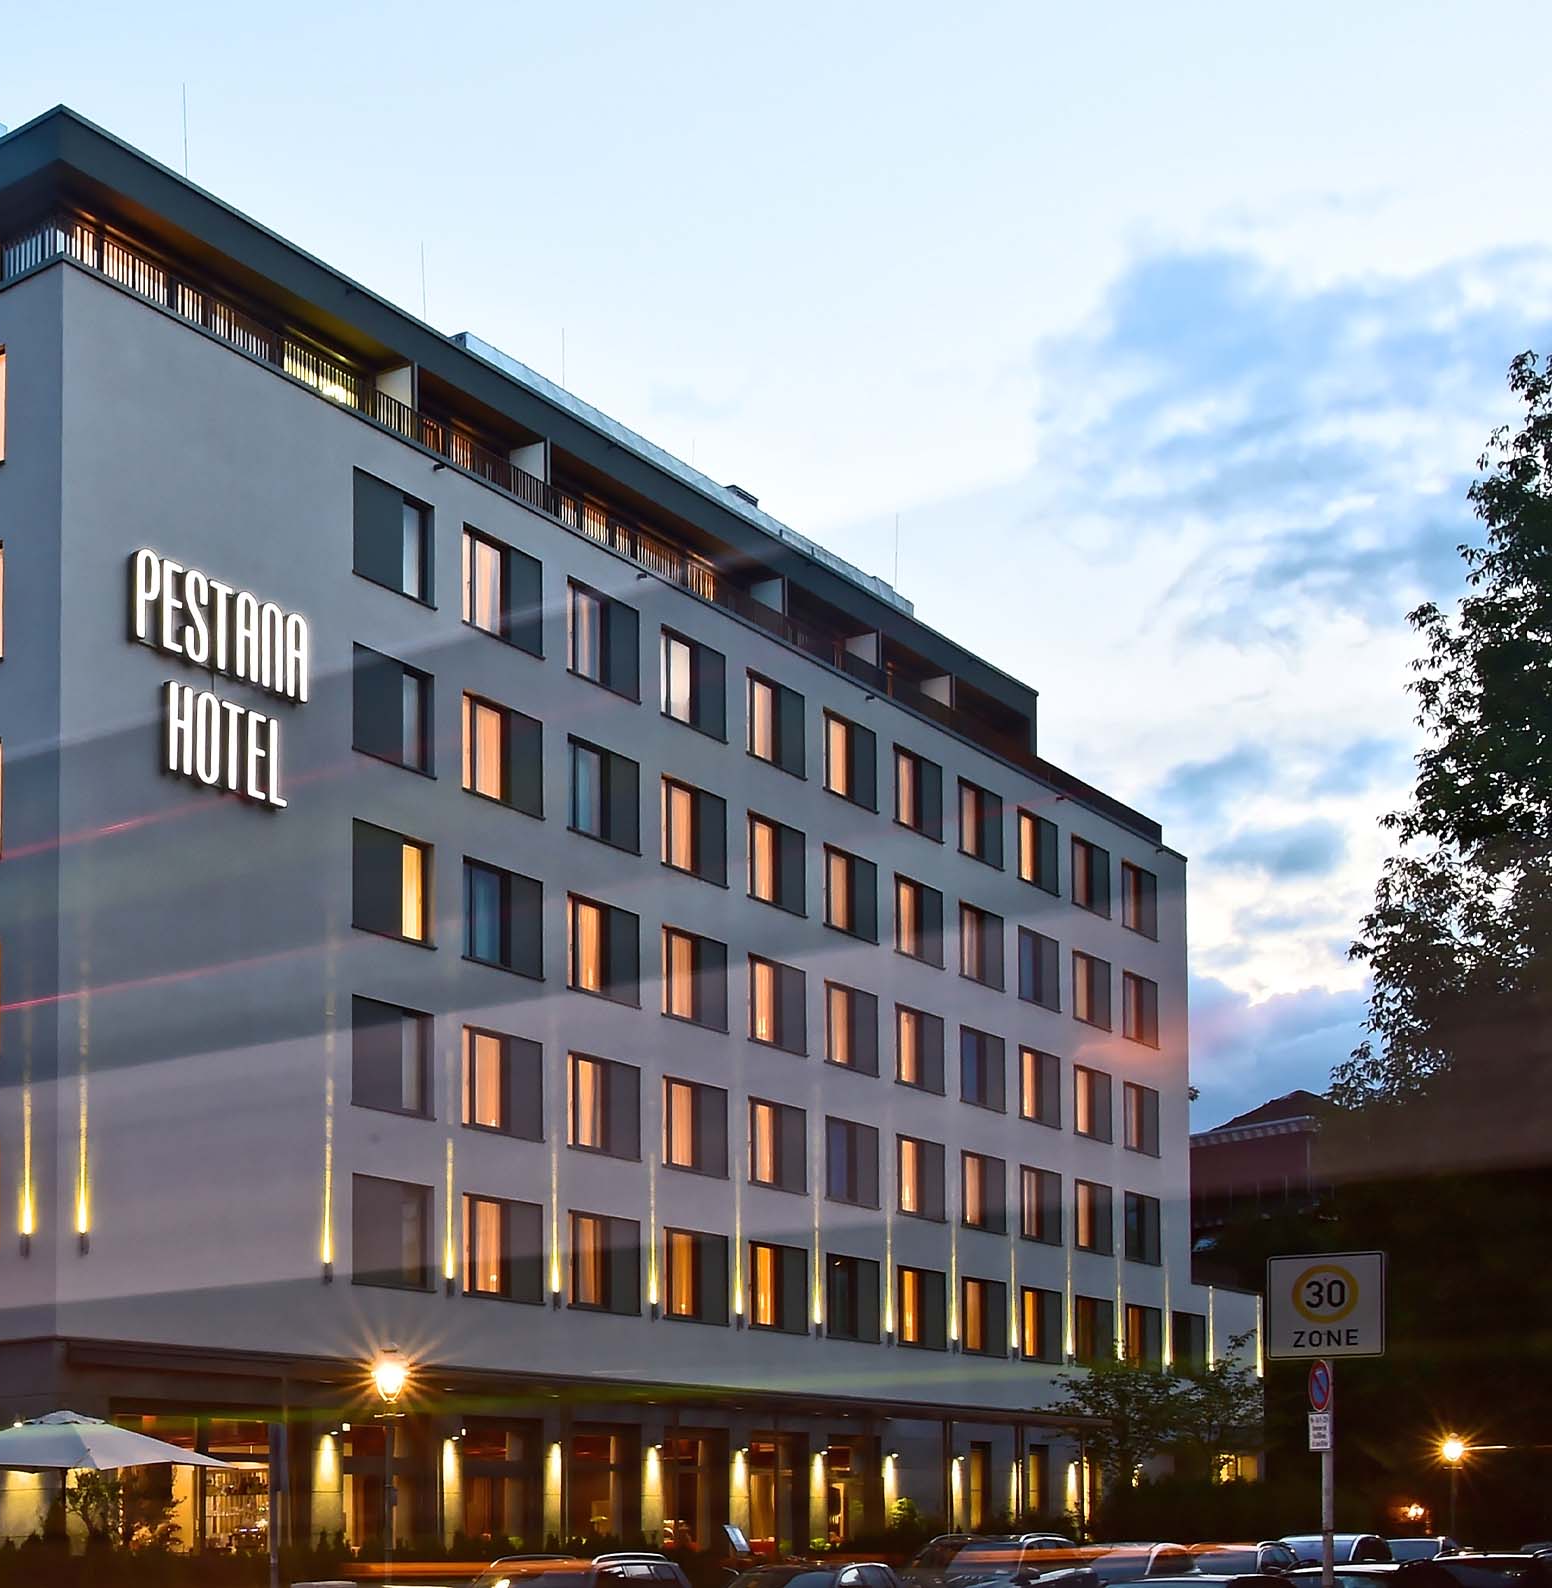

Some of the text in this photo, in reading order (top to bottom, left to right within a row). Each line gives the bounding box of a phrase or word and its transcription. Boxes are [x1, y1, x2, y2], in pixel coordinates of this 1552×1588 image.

[133, 547, 309, 704] PESTANA
[167, 680, 288, 809] HOTEL
[1305, 1279, 1346, 1309] 30
[1292, 1328, 1360, 1348] ZONE
